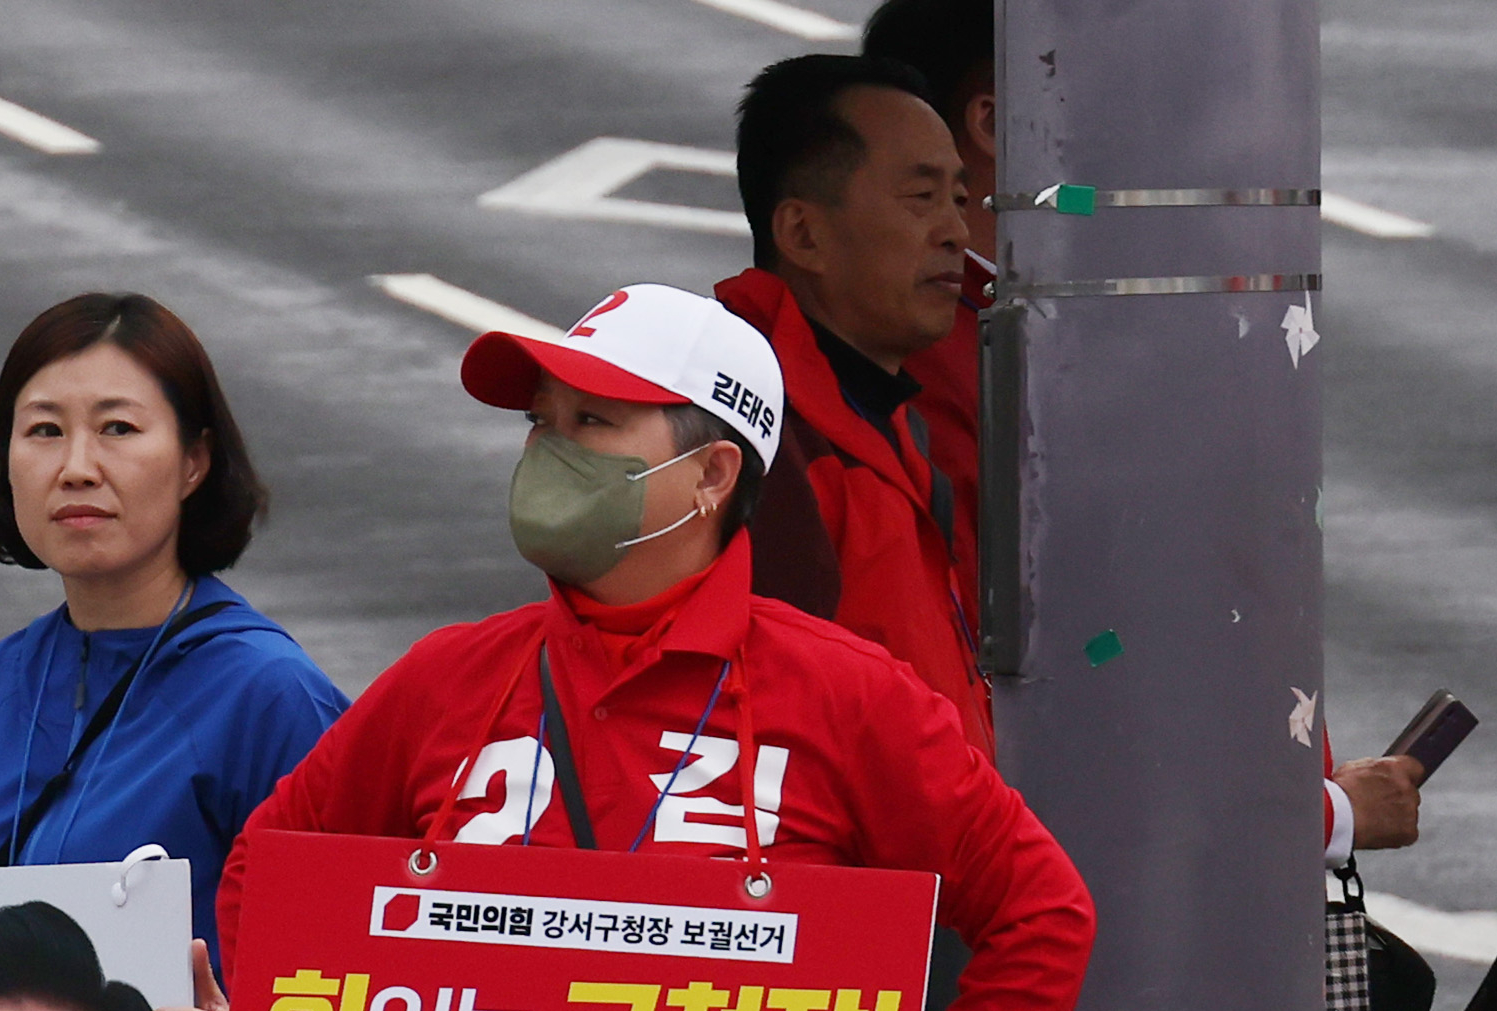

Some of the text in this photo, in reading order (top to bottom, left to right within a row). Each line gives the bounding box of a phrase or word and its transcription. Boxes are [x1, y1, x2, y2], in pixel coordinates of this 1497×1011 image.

[568, 290, 629, 338] 2
[712, 371, 776, 439] 김태우
[428, 902, 786, 954] 국민의힘 강서구청장 보궐선거
